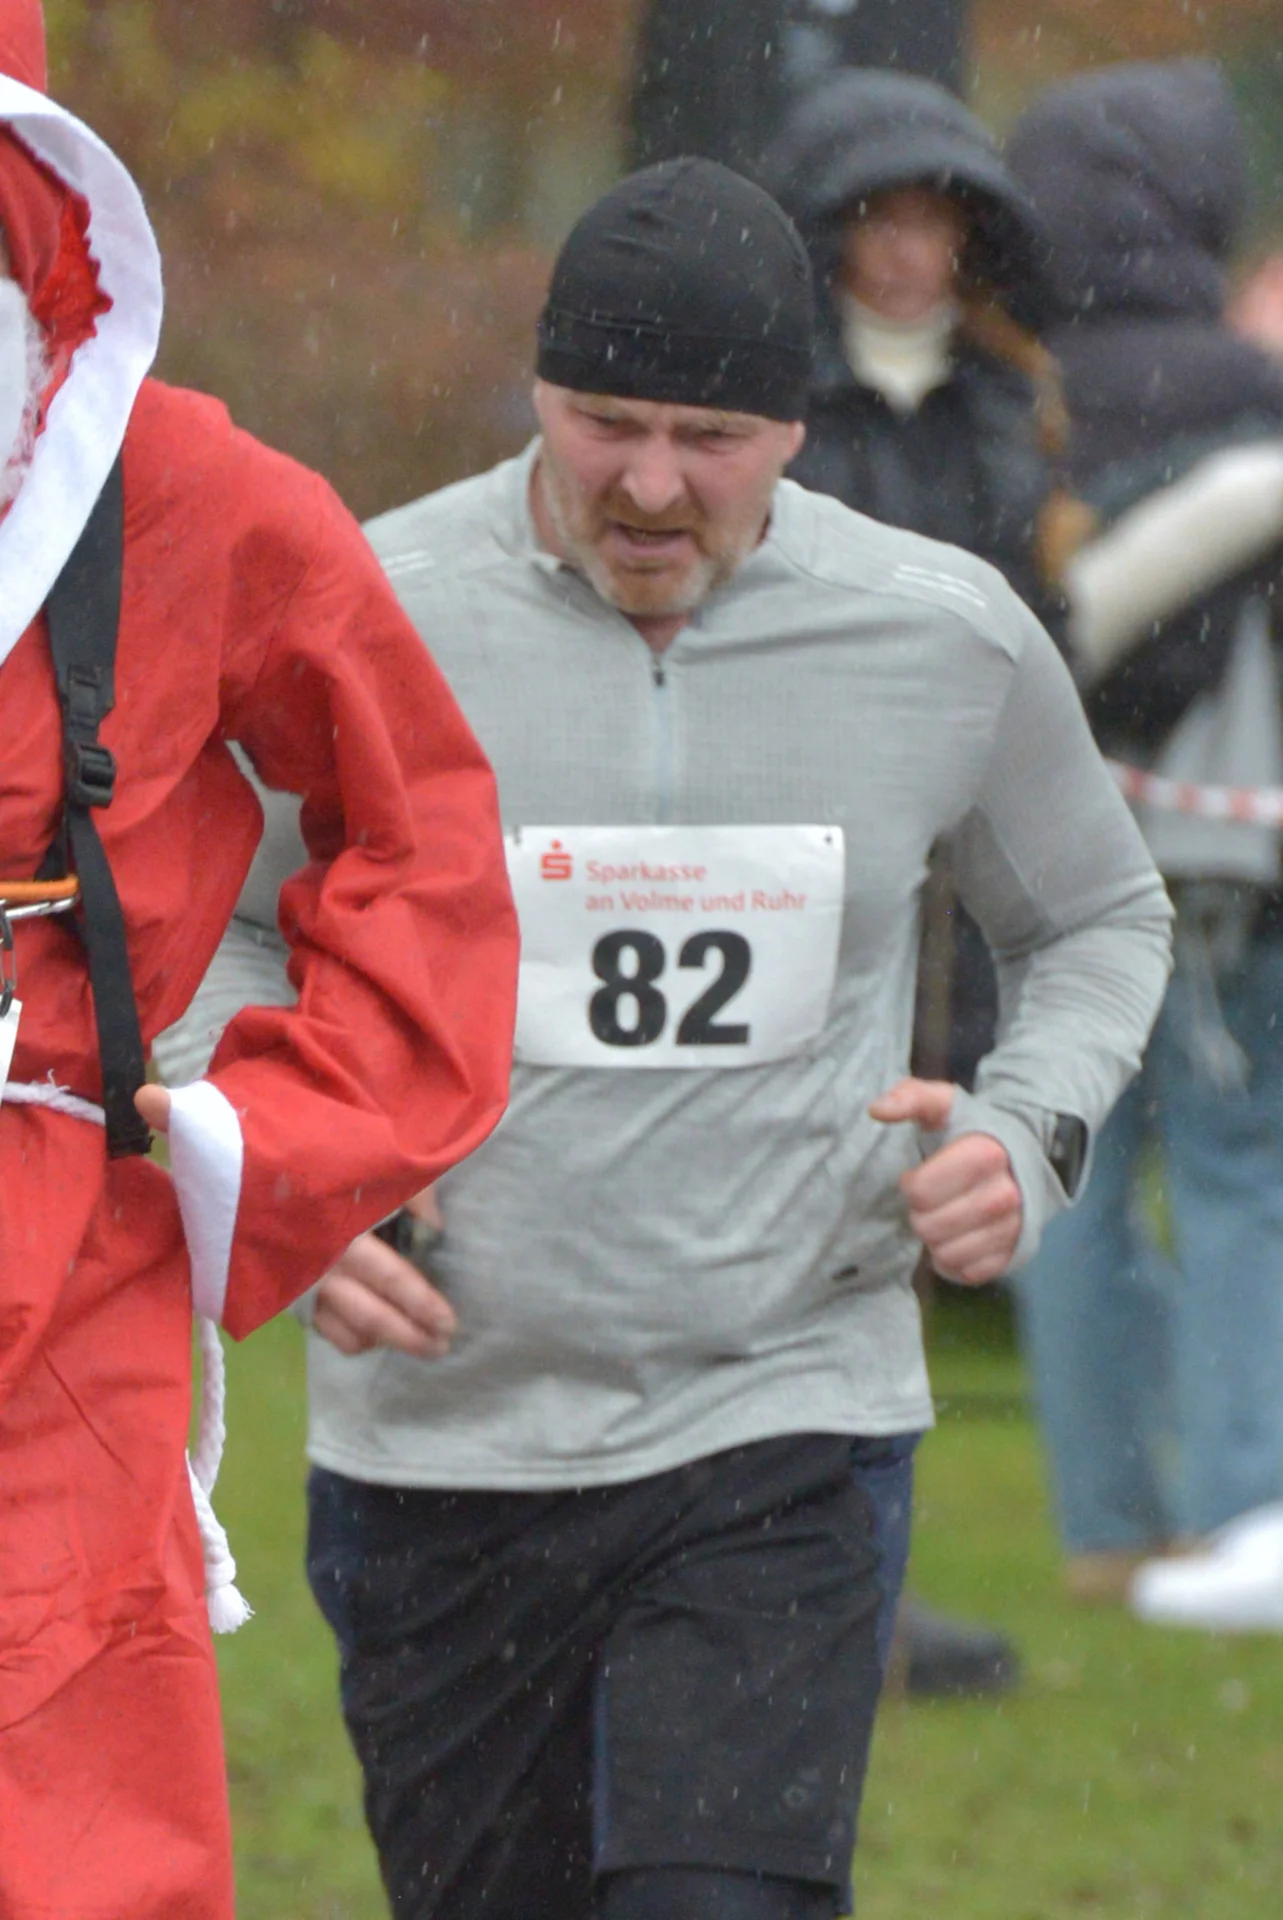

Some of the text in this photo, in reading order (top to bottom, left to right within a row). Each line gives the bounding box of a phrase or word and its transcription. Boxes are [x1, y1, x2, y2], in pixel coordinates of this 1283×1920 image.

[586, 861, 707, 883] Sparkasse
[586, 890, 806, 911] an Volme und Ruhr
[589, 928, 752, 1047] 82
